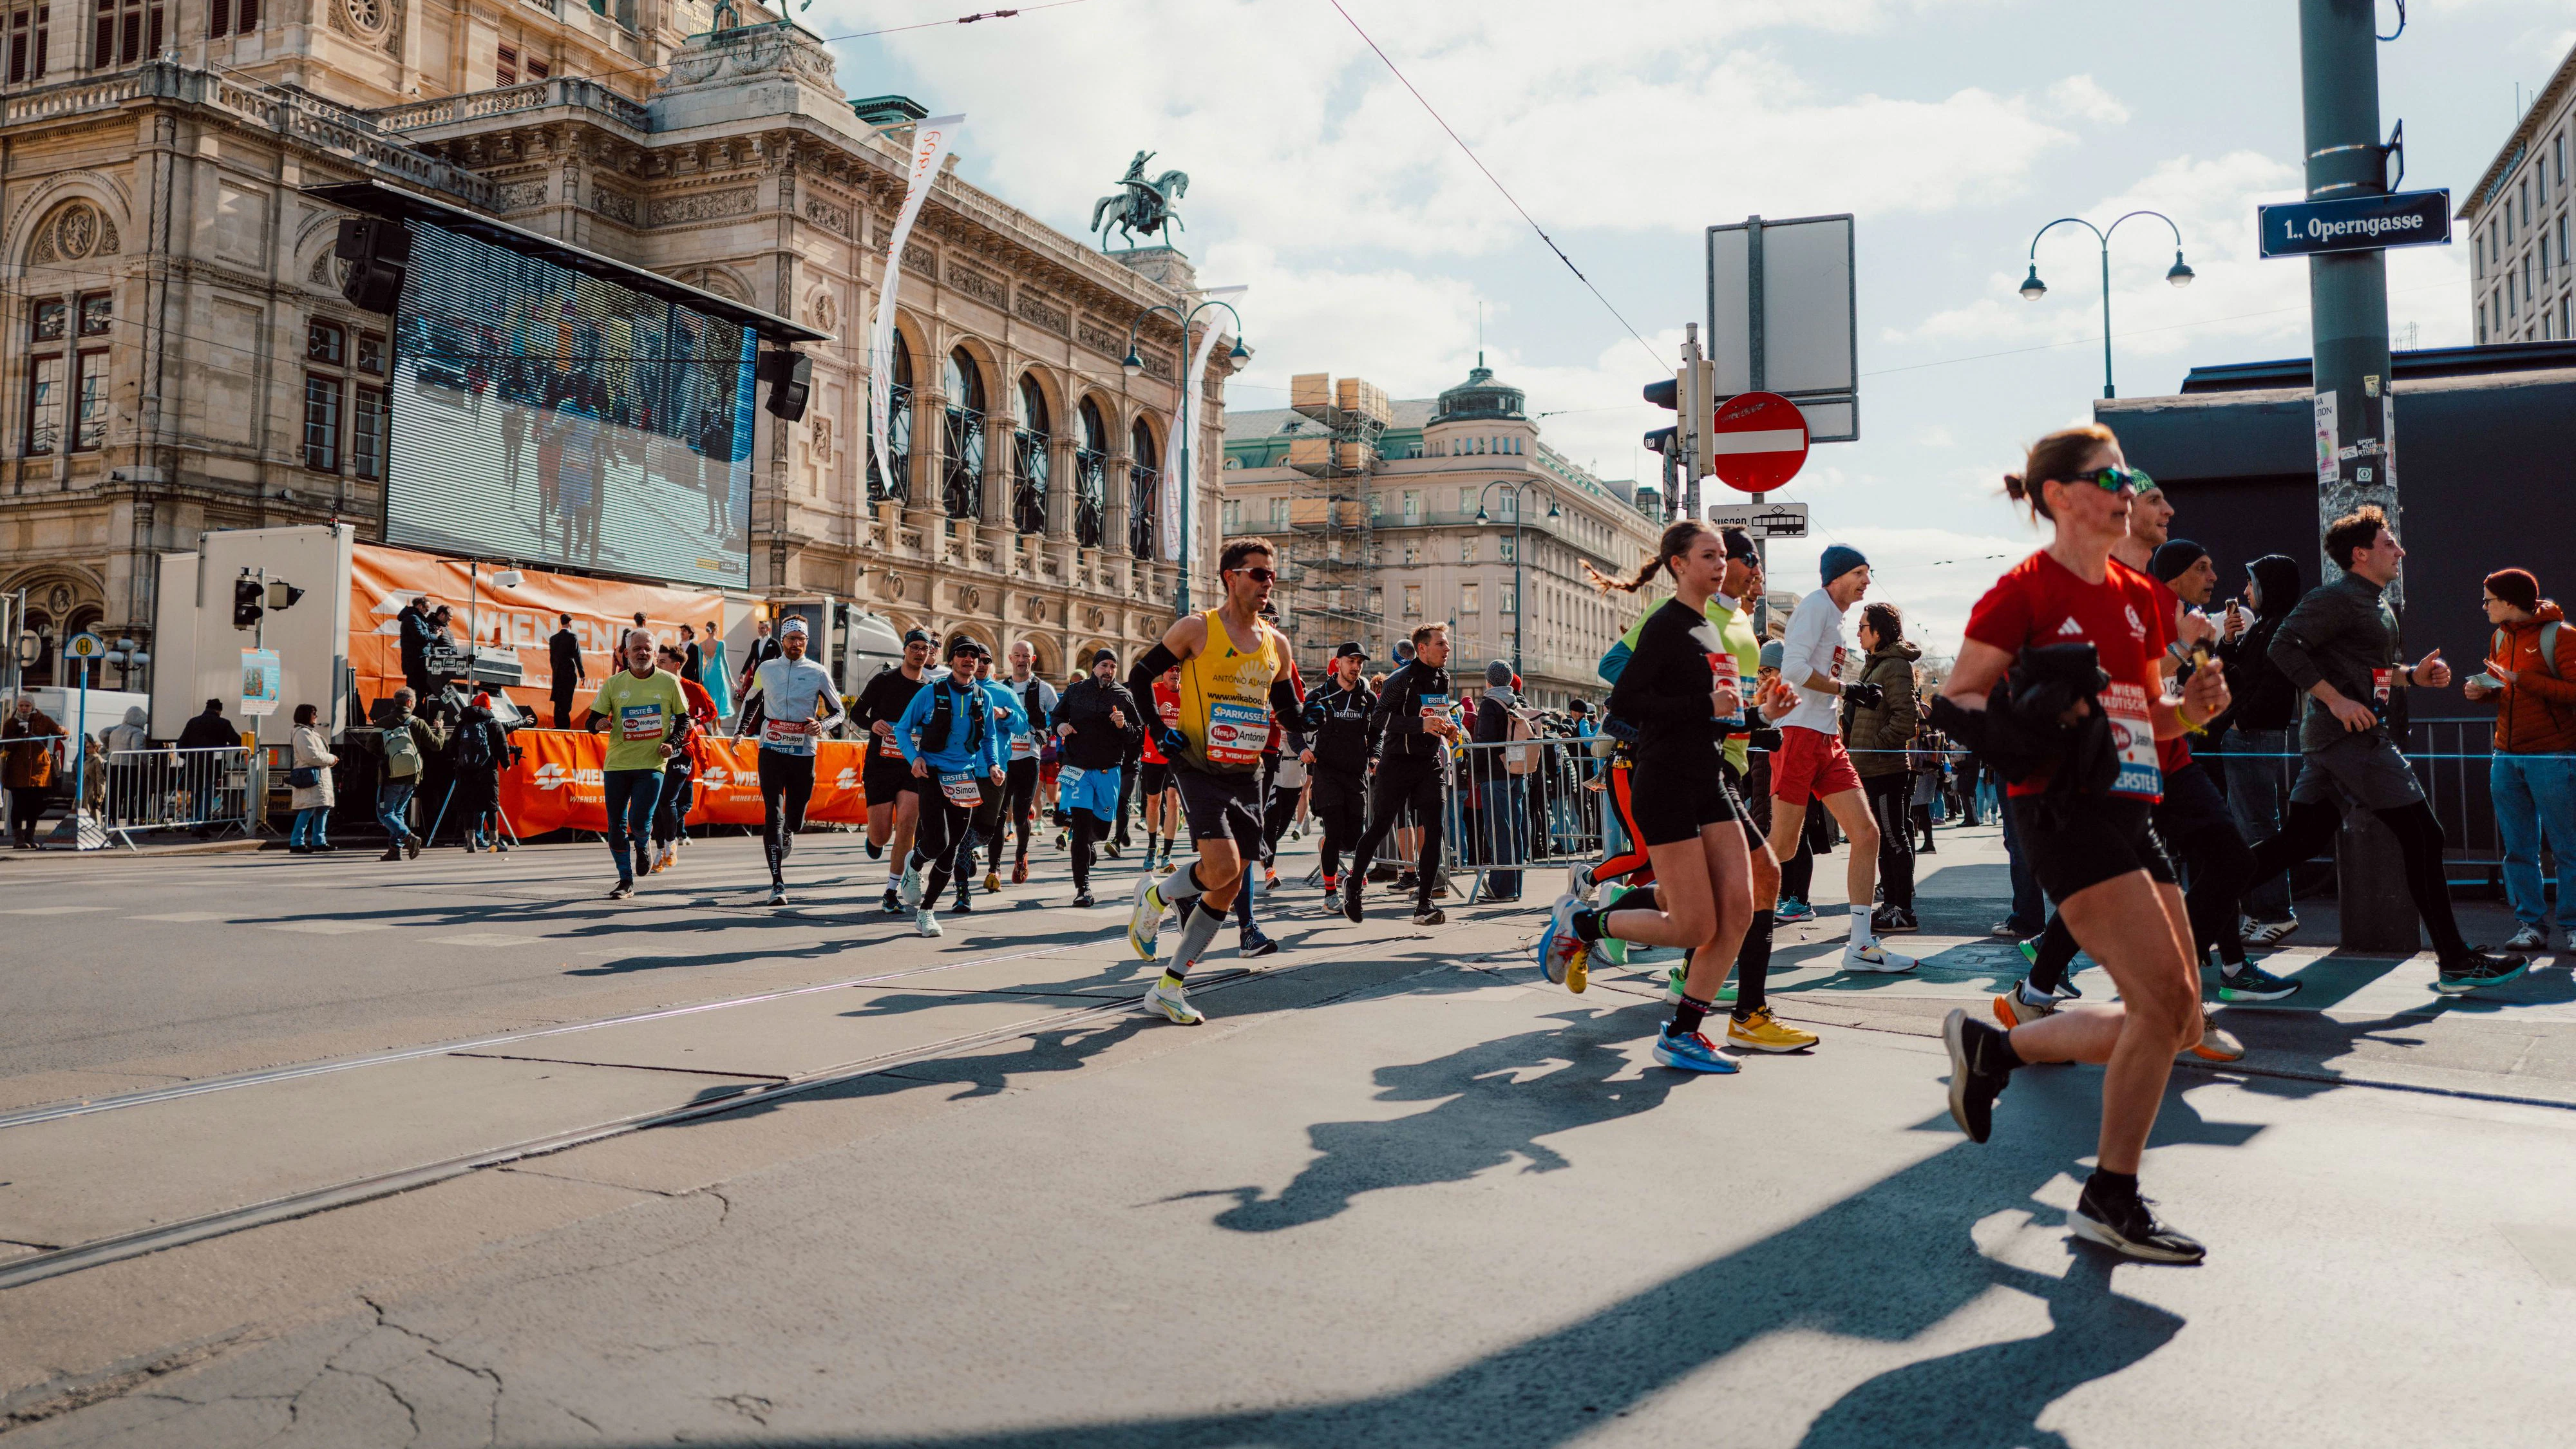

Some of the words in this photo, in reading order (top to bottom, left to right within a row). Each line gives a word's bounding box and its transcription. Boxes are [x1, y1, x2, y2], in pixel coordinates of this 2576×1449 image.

[914, 131, 941, 178] 1869
[2307, 214, 2423, 242] Operngasse
[460, 607, 559, 650] WIEN
[1213, 674, 1247, 684] ANTÓNIO
[1214, 707, 1261, 722] SPARKASSE
[624, 719, 638, 728] Hervis
[767, 732, 781, 741] Hervis
[1213, 728, 1236, 739] Hervis
[1238, 730, 1265, 743] António
[1065, 766, 1081, 777] Thomas
